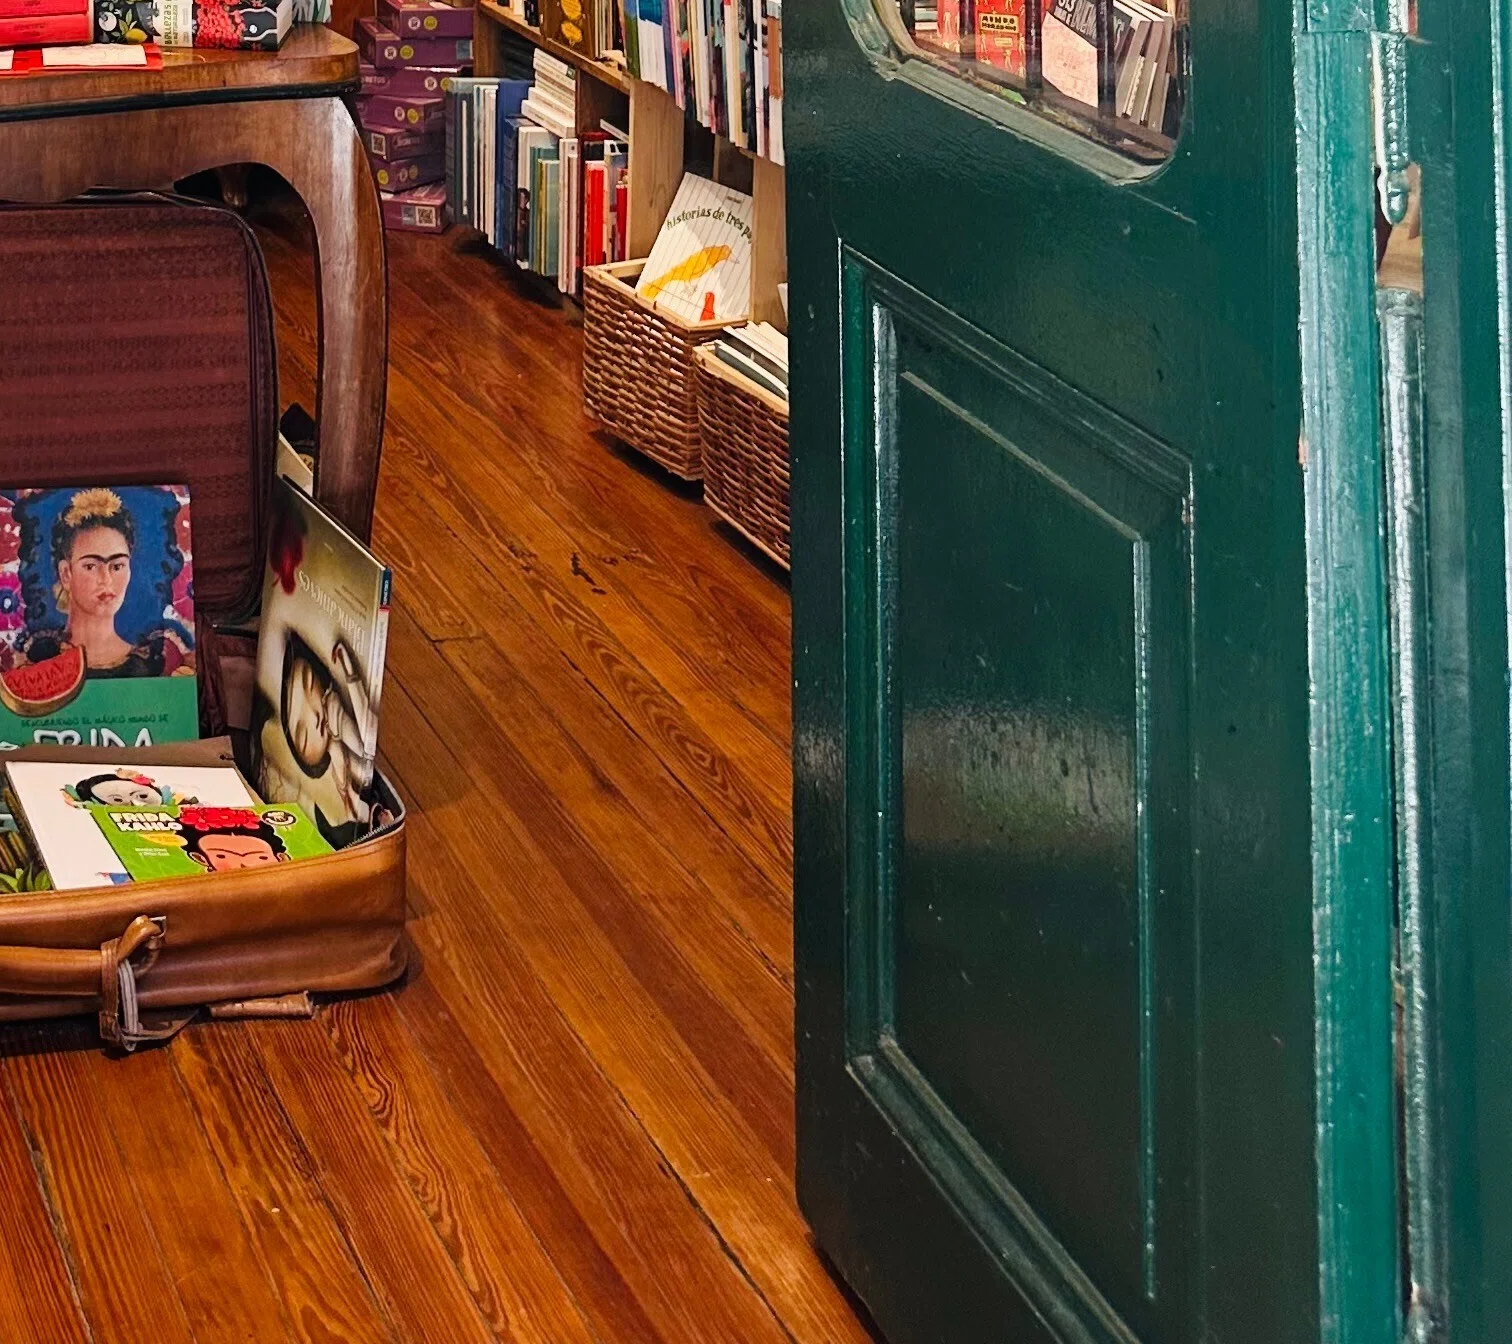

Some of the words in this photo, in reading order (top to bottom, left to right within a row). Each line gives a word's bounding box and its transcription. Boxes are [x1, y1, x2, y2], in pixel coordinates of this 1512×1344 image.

[666, 206, 712, 230] historias
[712, 206, 725, 221] de
[725, 211, 745, 231] tres
[109, 812, 176, 823] FRIDA
[116, 821, 183, 832] KAHLO
